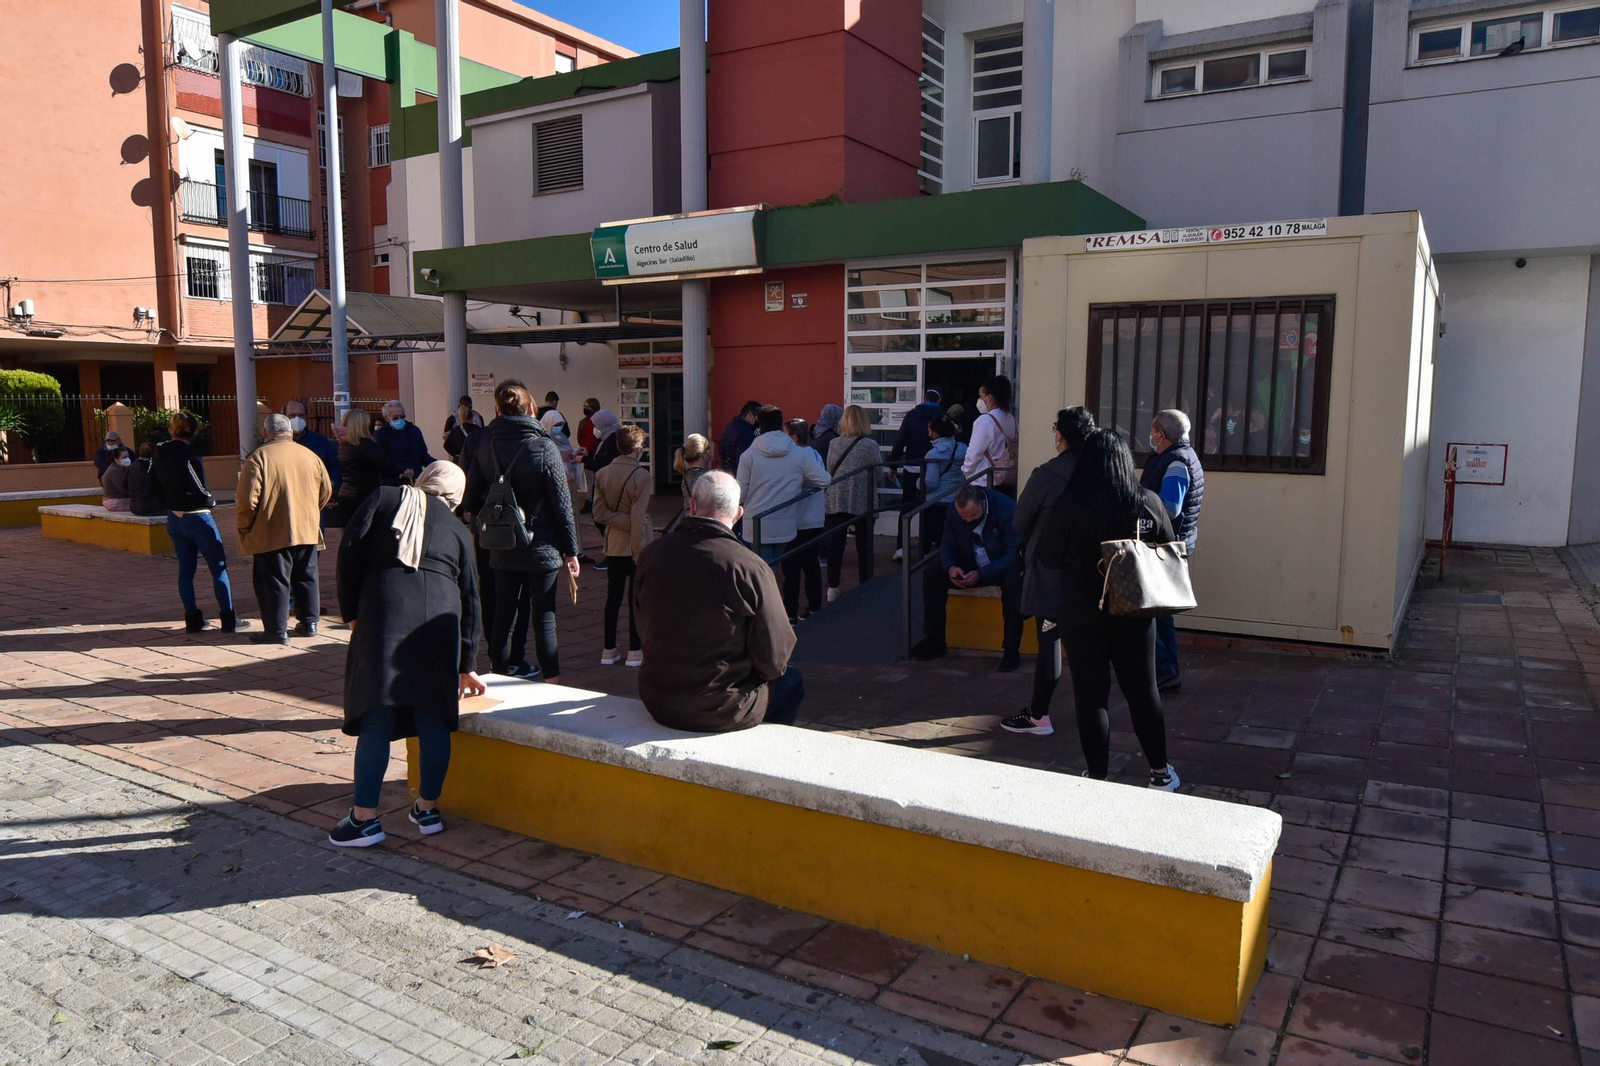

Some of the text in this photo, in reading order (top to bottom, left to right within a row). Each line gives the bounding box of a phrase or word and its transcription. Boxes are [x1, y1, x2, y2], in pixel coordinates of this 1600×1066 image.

[1223, 223, 1301, 239] 952 42 10 78
[1301, 222, 1326, 231] MALAGA
[634, 239, 698, 255] Centro de Salud
[1093, 232, 1161, 248] REMSA
[636, 259, 658, 268] Algeciras
[669, 255, 695, 264] (Saladillo)
